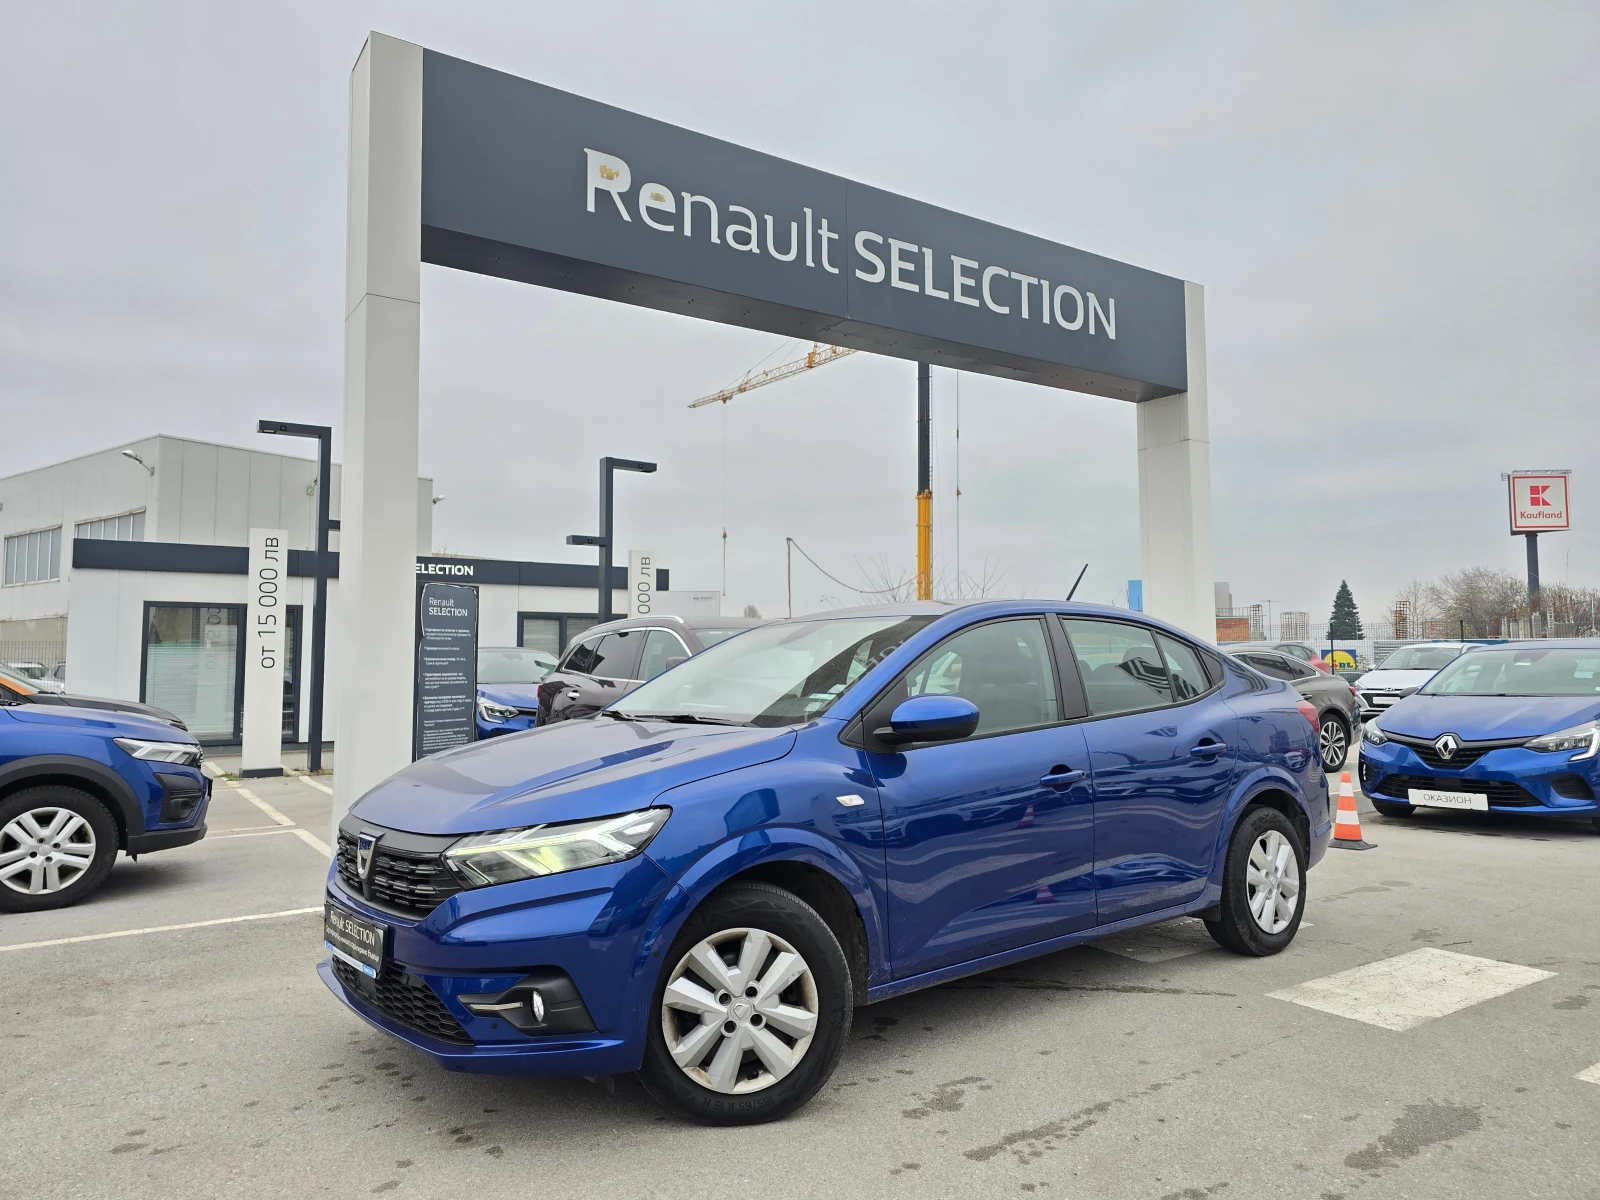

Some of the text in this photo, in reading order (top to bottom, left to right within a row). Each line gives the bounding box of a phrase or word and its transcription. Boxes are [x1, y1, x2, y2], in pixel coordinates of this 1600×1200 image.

[583, 147, 1117, 341] Renault SELECTION
[1520, 510, 1563, 519] Kaufland
[258, 568, 278, 608] 000
[637, 581, 651, 614] 000
[428, 597, 455, 607] Renault
[428, 607, 468, 617] SELECTION
[257, 614, 277, 638] 15
[1422, 793, 1472, 805] ОКАЗИОН
[345, 919, 375, 946] SELECTION
